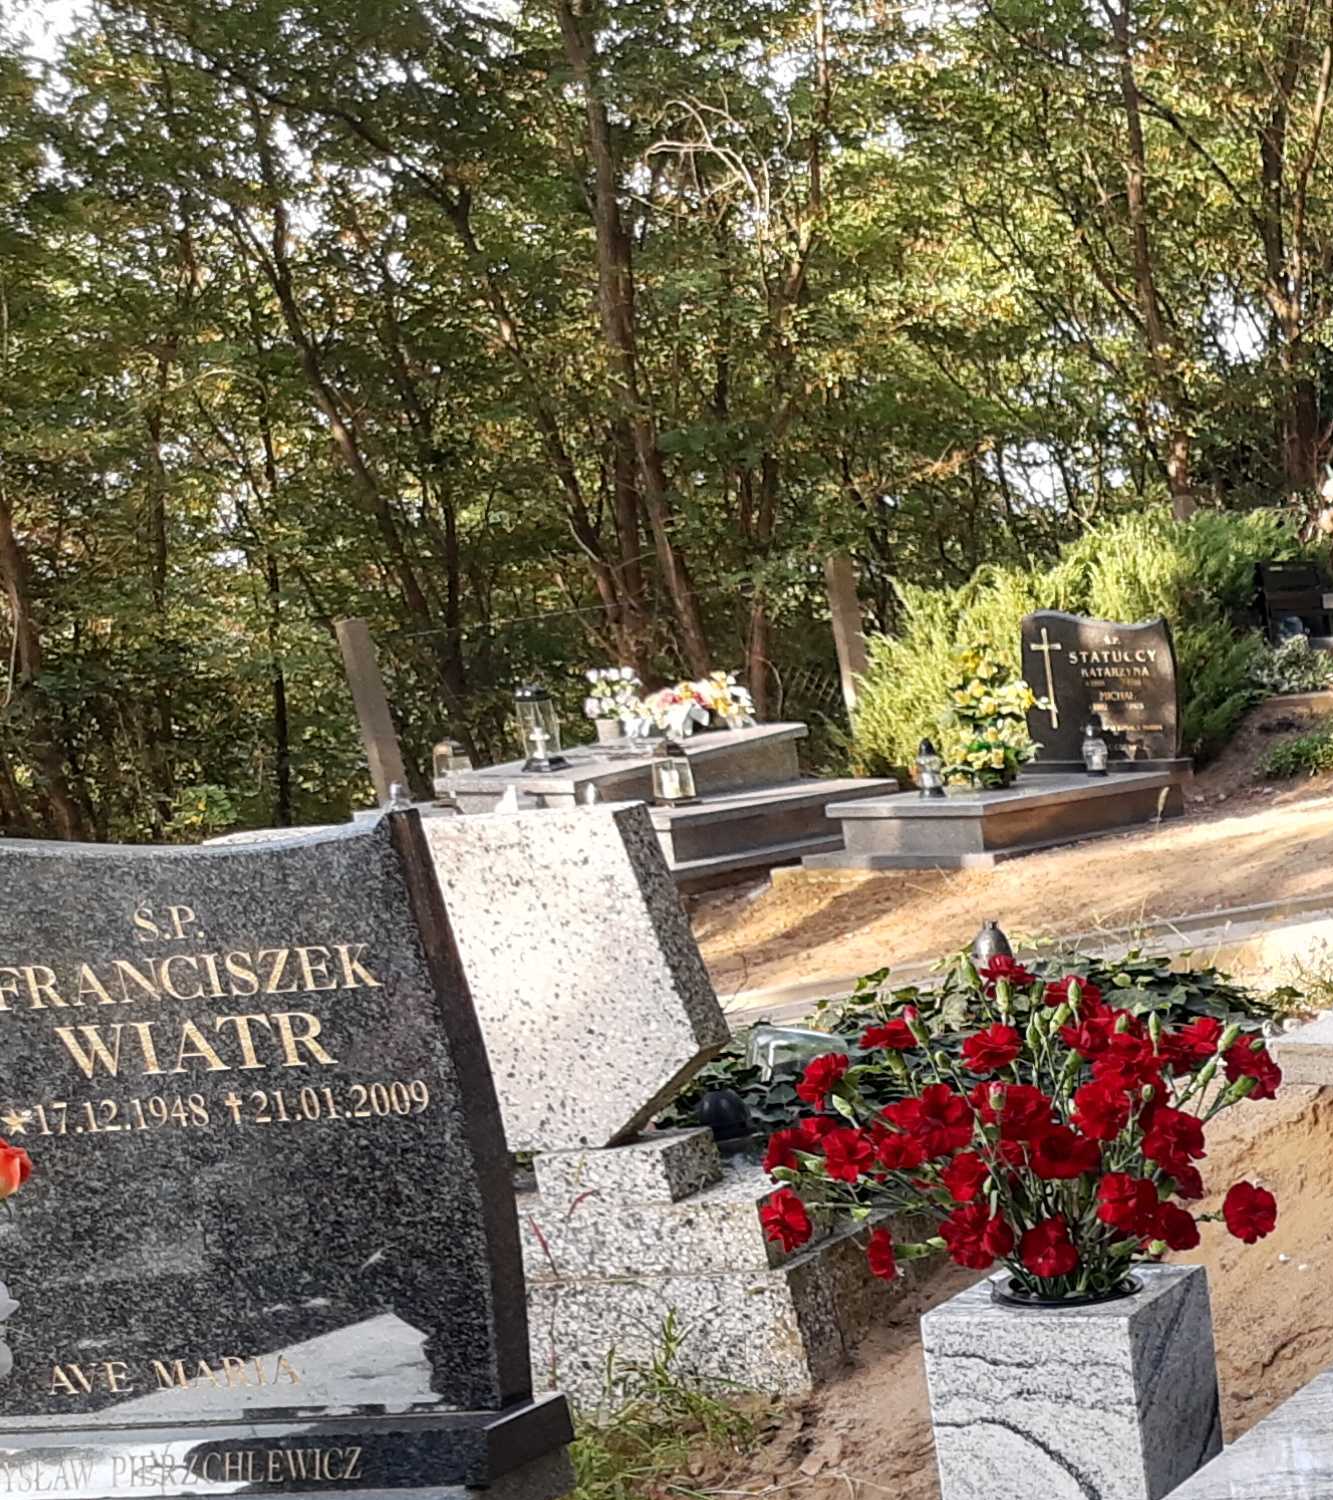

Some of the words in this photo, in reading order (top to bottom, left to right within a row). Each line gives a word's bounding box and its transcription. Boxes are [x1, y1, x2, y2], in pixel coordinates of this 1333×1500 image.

[133, 900, 205, 943] Ś.P.
[0, 943, 384, 1012] FRANCISZEK
[54, 1011, 339, 1081] WIATR
[50, 1360, 134, 1396] AVE
[152, 1354, 301, 1391] MARIA
[111, 1446, 364, 1490] PIERZCHLEWICZ
